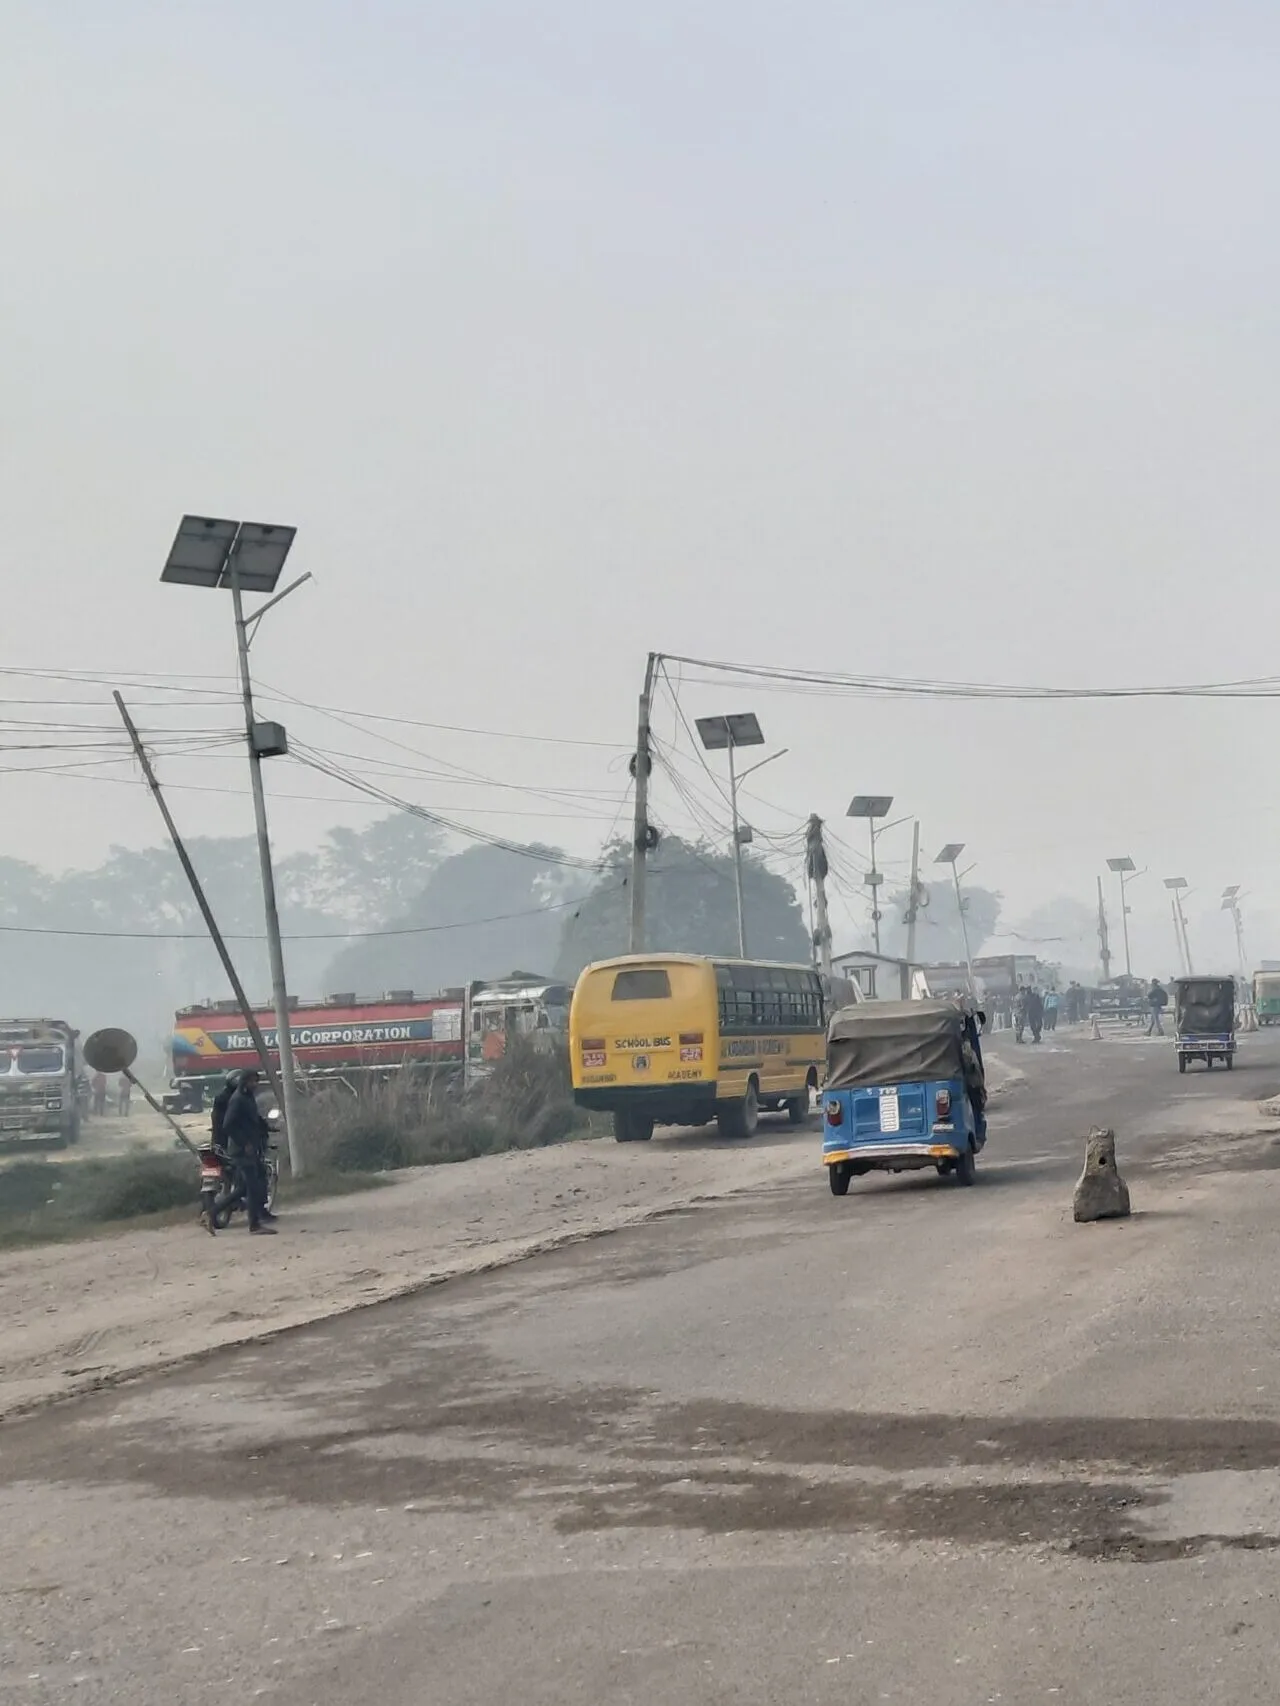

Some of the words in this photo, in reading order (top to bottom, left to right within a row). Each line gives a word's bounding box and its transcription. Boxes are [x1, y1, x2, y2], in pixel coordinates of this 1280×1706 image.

[228, 1034, 274, 1048] NEPL
[300, 1026, 411, 1044] CORPORATION
[614, 1037, 651, 1049] SCHOOL
[653, 1036, 671, 1047] BUS
